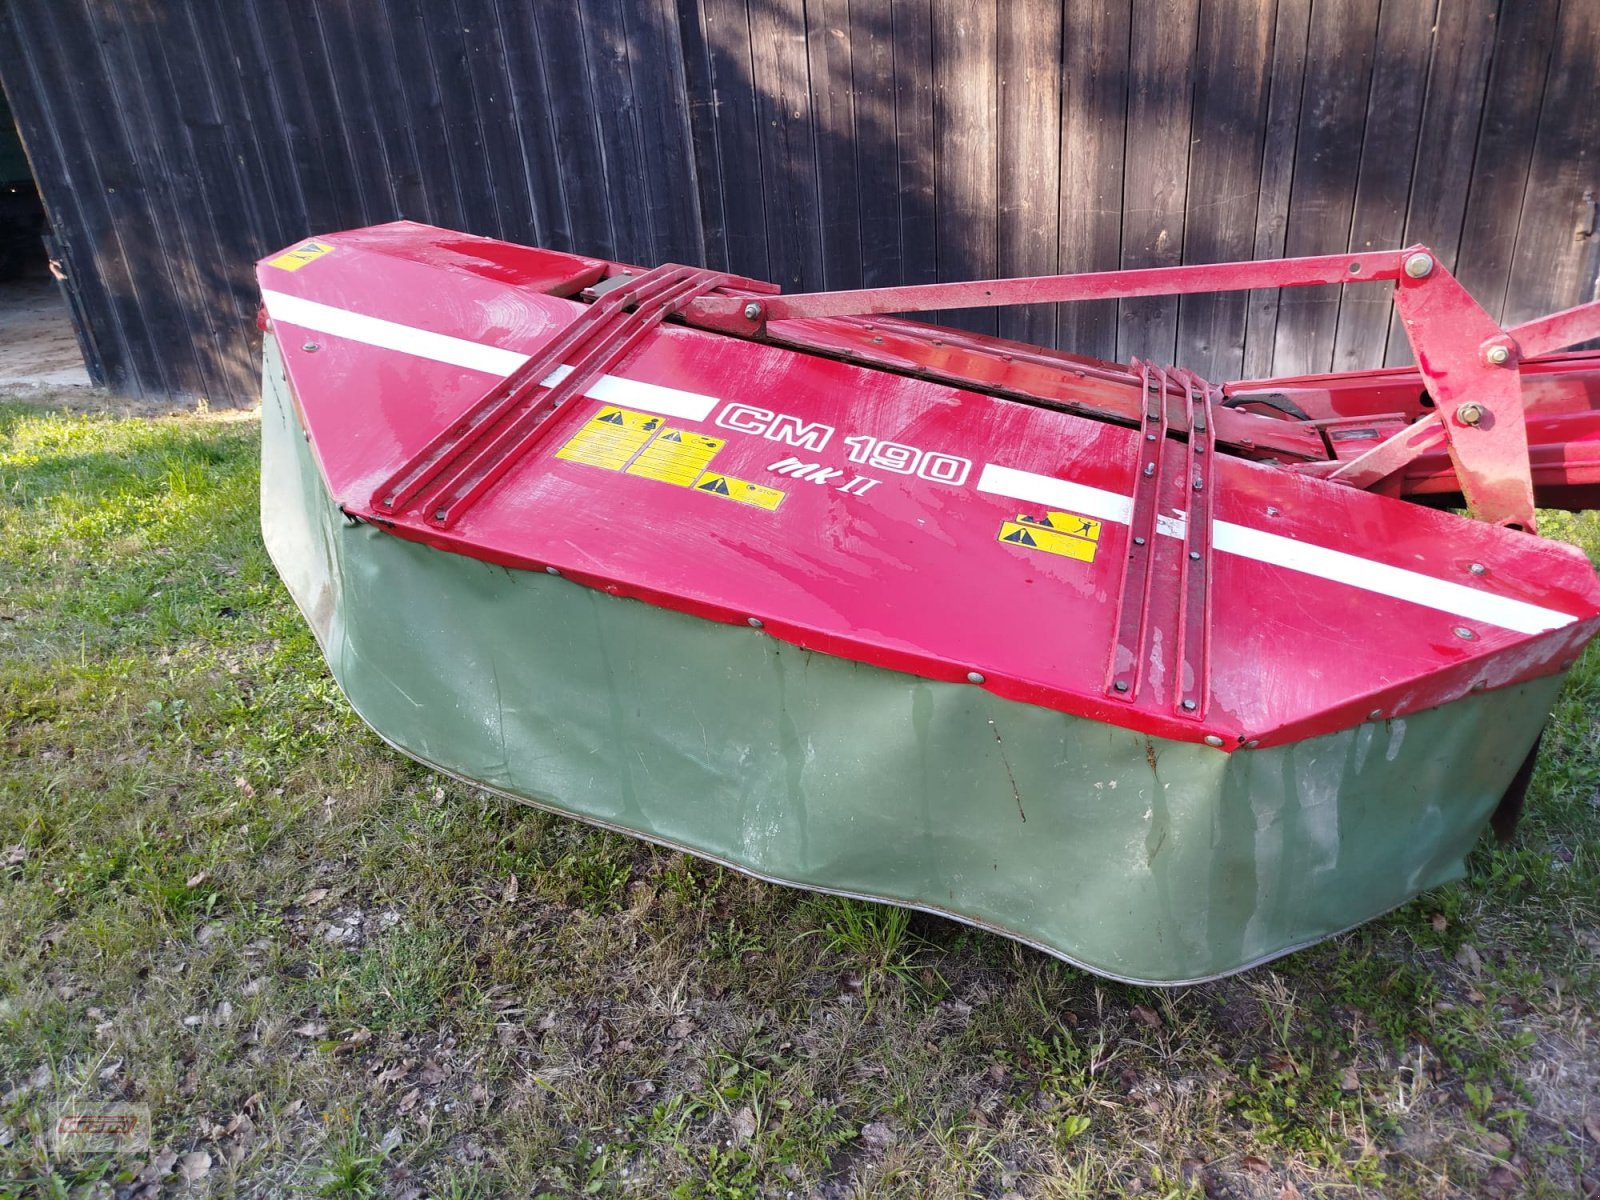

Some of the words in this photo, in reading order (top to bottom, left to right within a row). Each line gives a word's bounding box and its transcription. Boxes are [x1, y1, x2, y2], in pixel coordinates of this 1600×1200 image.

[714, 402, 836, 453] CM
[843, 435, 973, 486] 190
[835, 474, 883, 497] II
